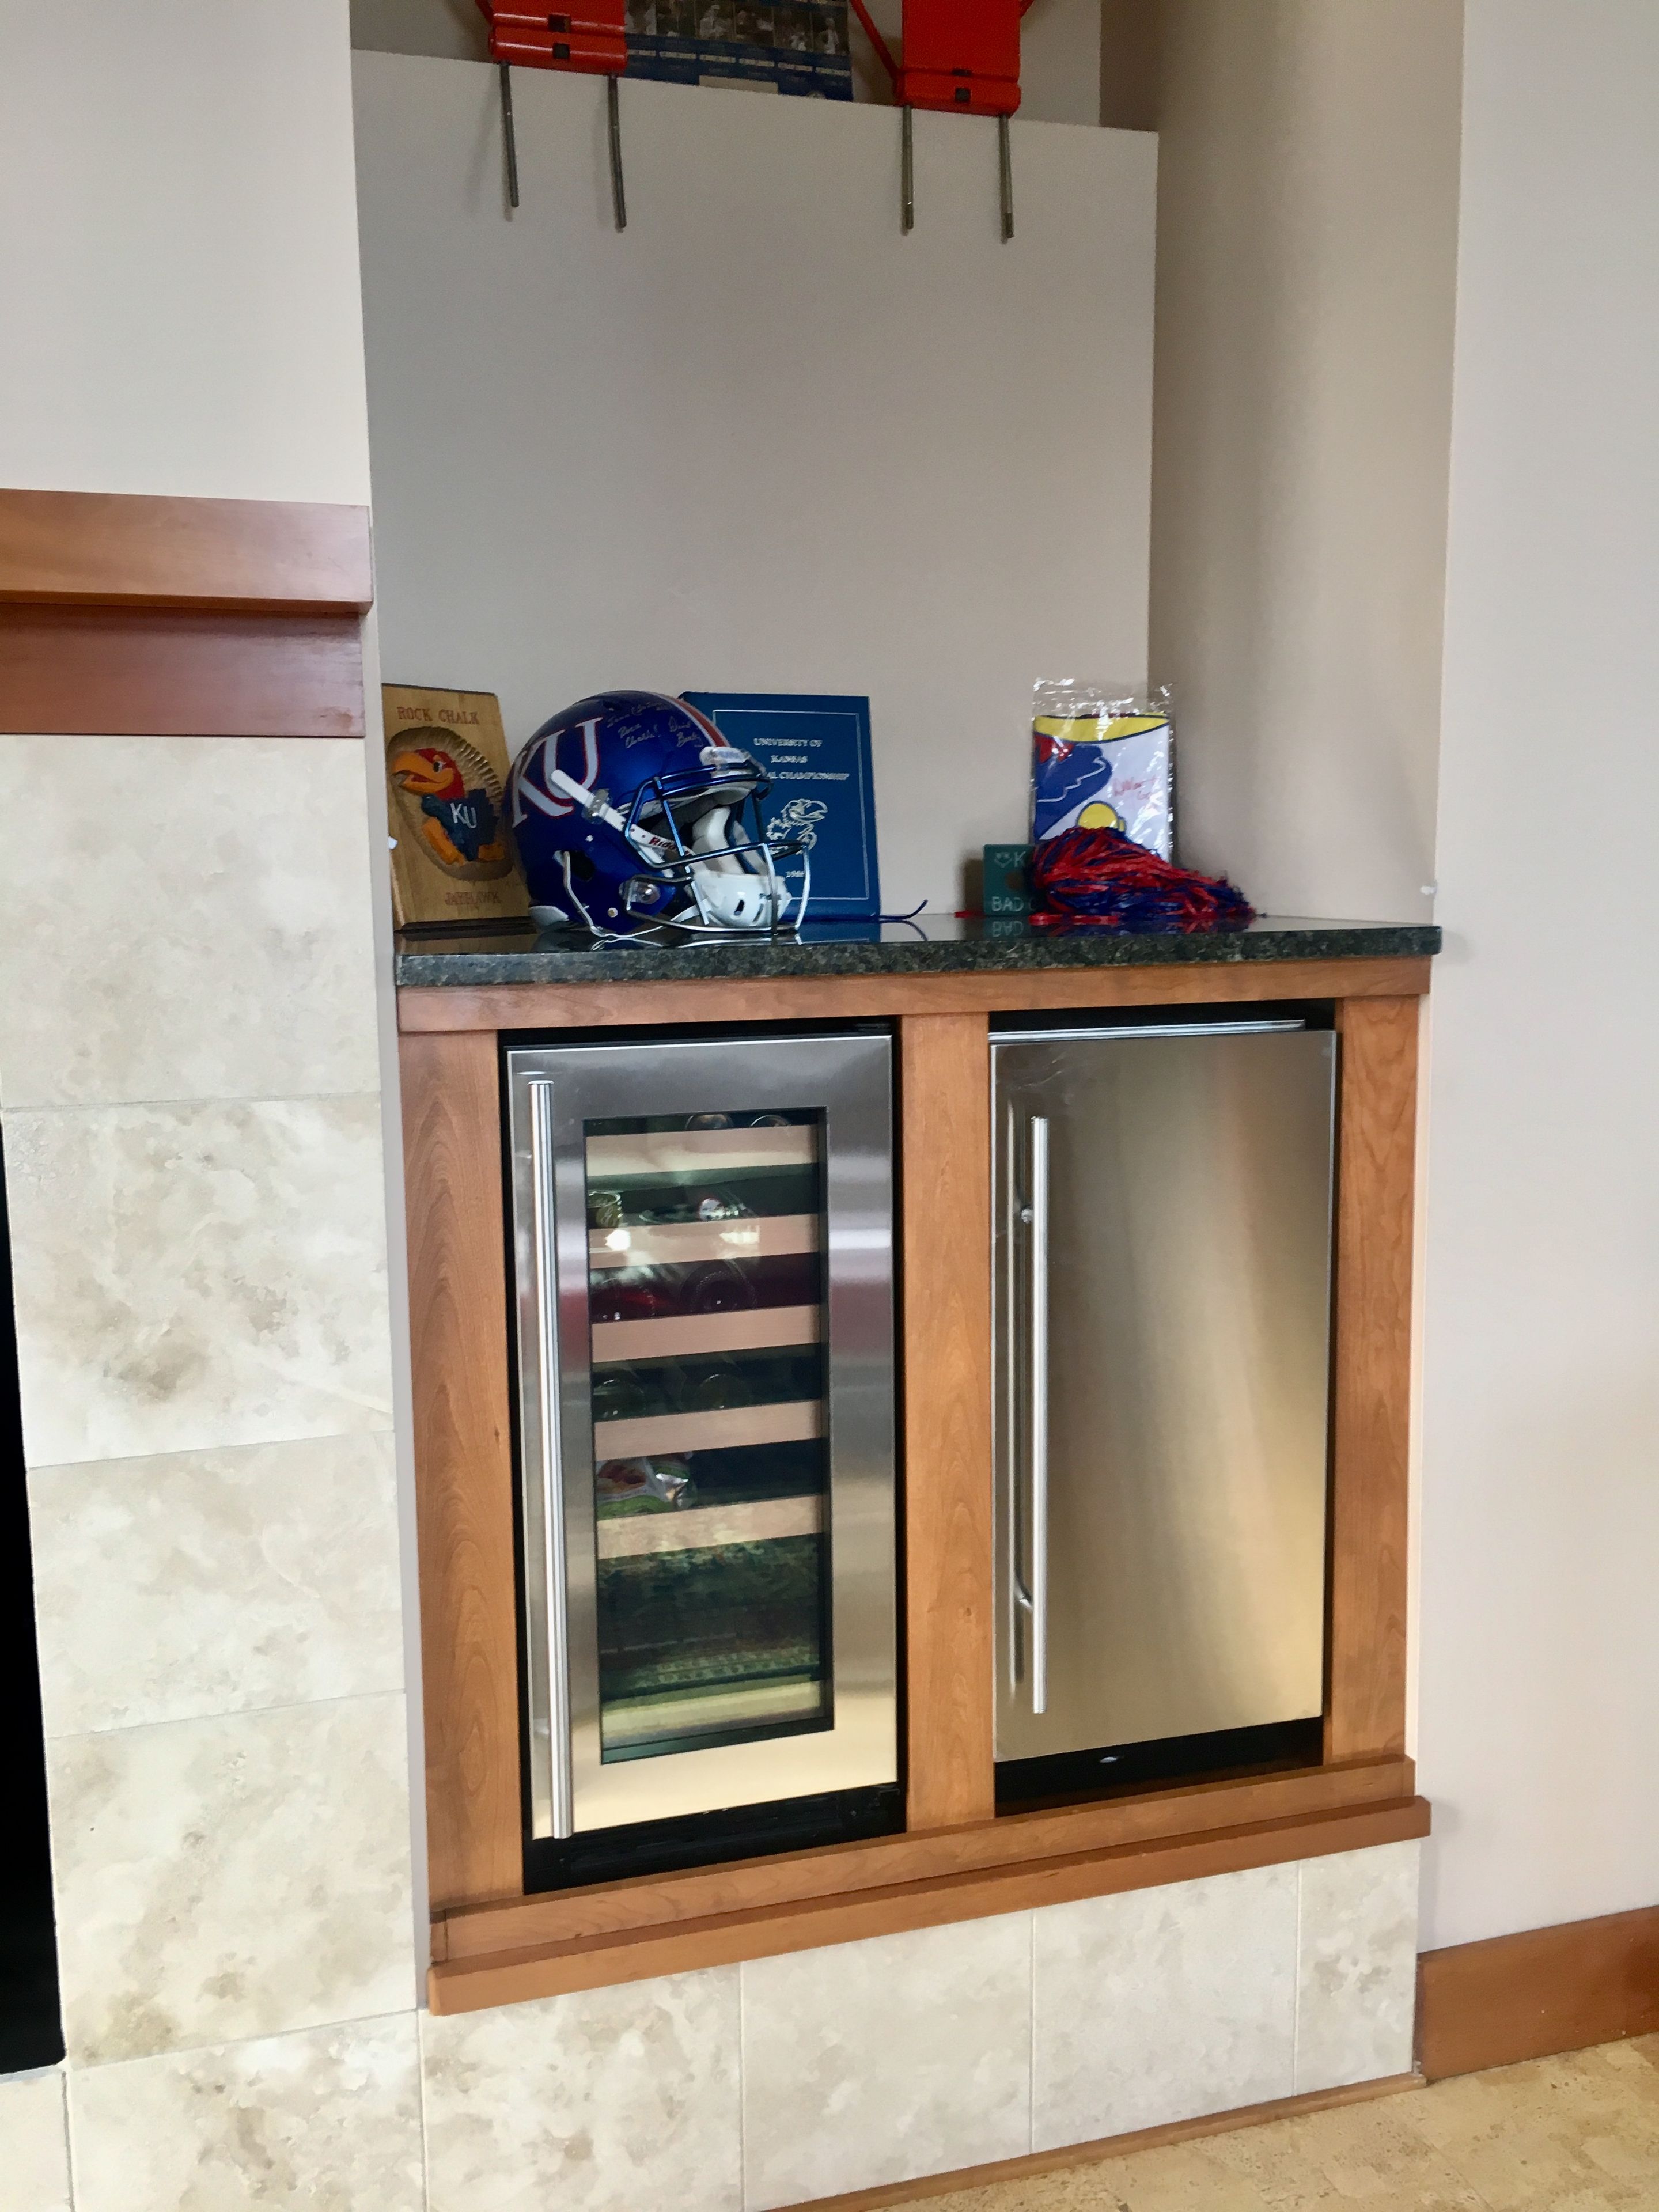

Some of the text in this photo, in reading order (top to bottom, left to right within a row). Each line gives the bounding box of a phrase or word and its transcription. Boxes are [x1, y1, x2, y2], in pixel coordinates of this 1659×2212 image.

[396, 706, 479, 725] ROCK CHALK
[753, 738, 823, 747] UNIVERSITY OF
[770, 755, 808, 763] KANSAS
[512, 717, 604, 827] KU
[450, 802, 477, 829] KU
[991, 896, 1024, 911] BAD
